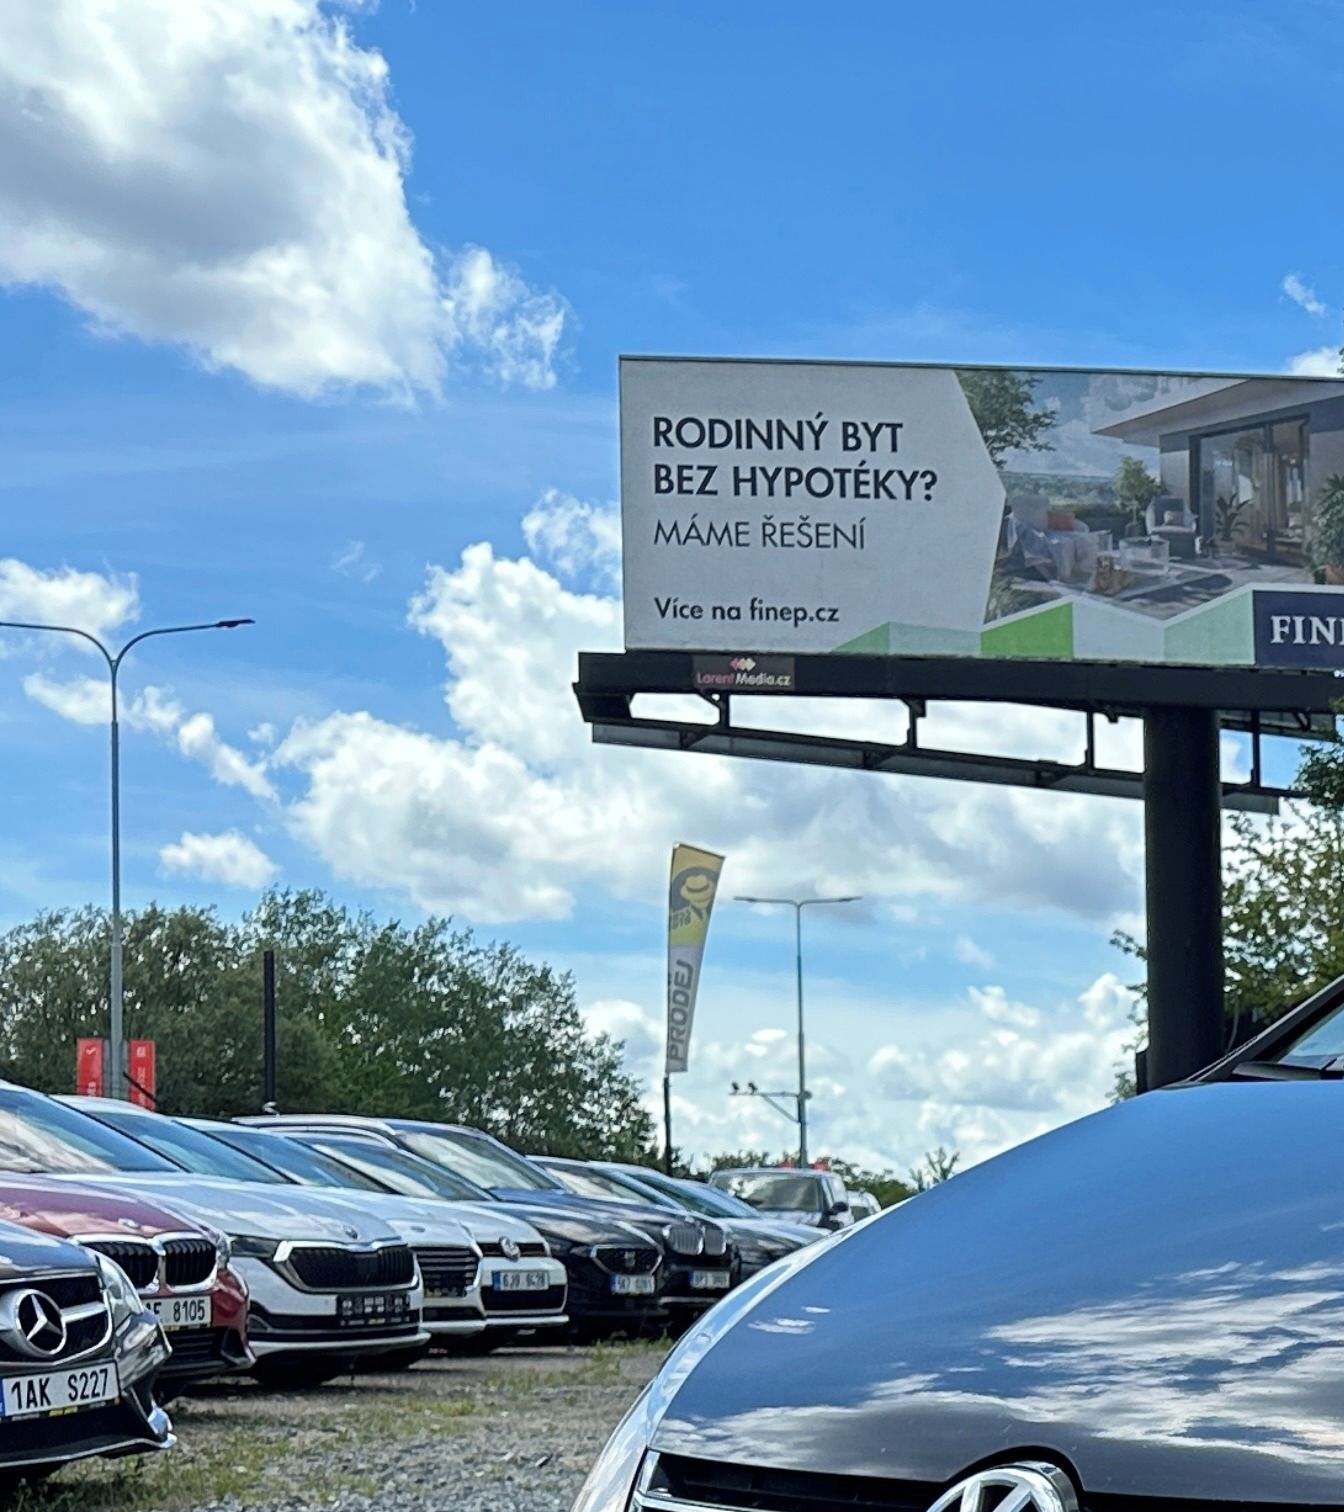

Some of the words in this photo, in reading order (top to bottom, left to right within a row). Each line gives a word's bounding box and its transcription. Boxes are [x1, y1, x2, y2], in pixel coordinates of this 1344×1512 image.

[653, 411, 828, 450] RODINNÝ
[842, 421, 903, 452] BYT
[654, 464, 718, 496] BEZ
[733, 460, 938, 501] HYPOTÉKY?
[653, 513, 750, 547] MÁME
[762, 514, 866, 550] ŘEŠENÍ
[654, 597, 703, 620] Více
[712, 604, 741, 621] na
[750, 597, 840, 627] finep.cz
[670, 959, 693, 1061] PRODEJ
[173, 1299, 205, 1322] 8105
[11, 1377, 51, 1409] 1AK
[68, 1368, 108, 1402] S227
